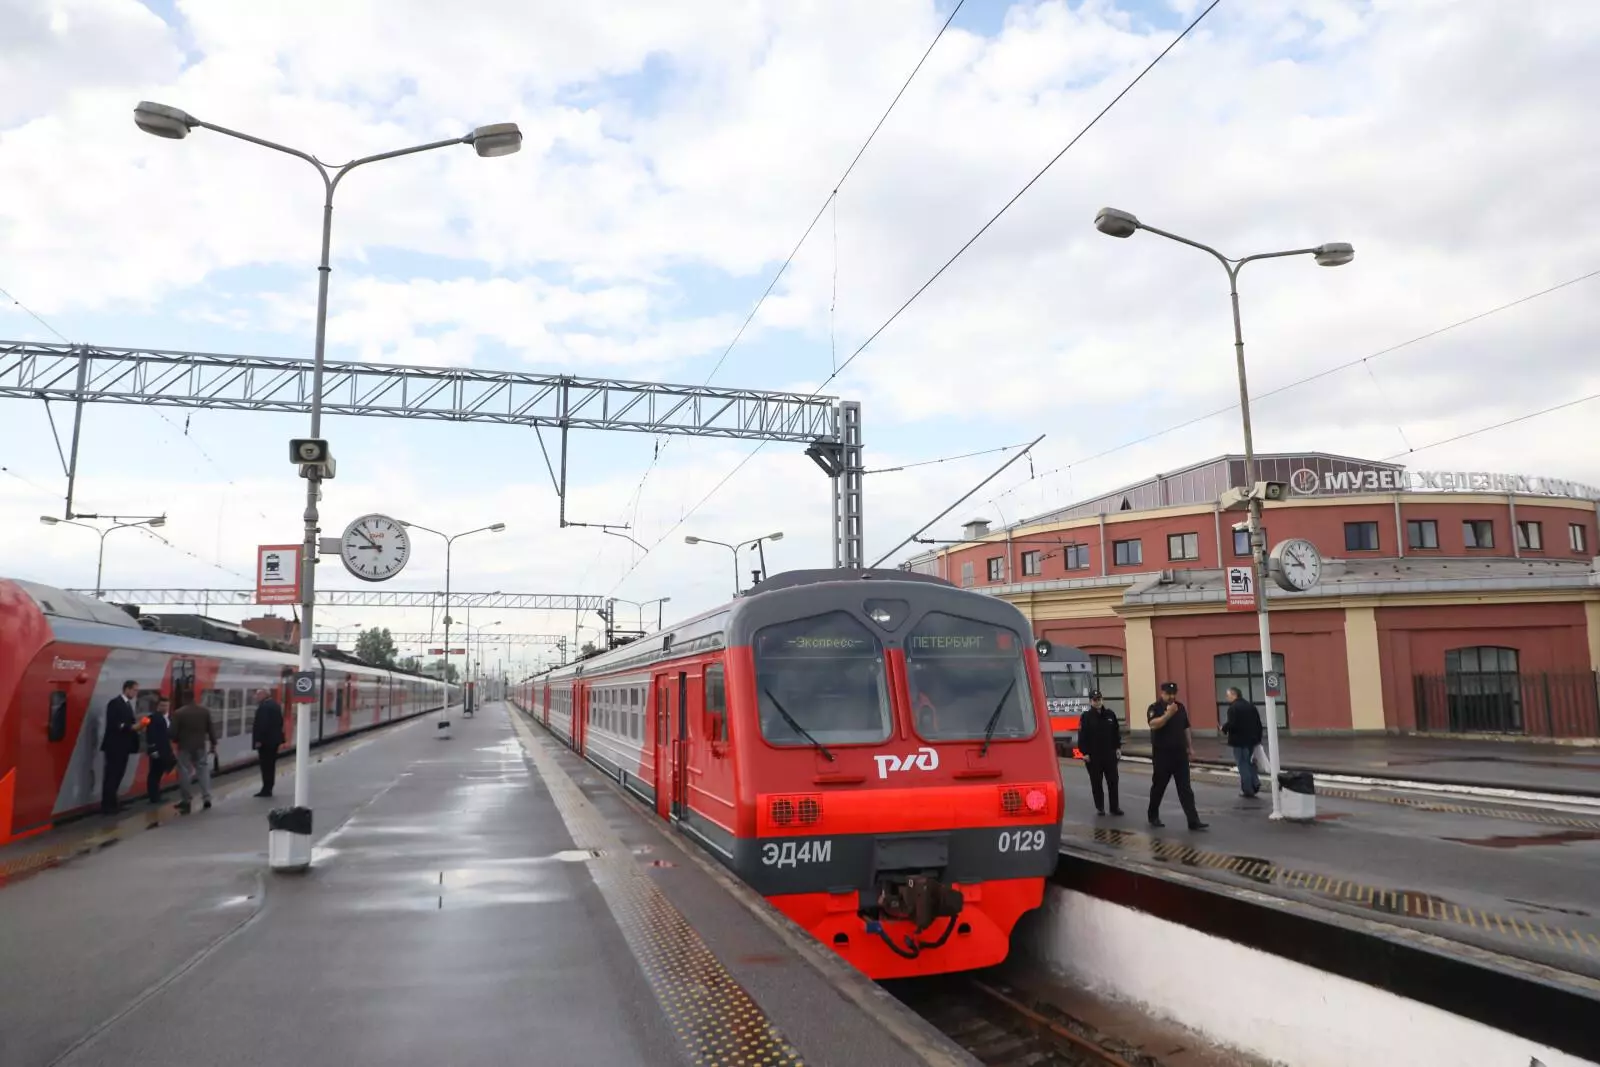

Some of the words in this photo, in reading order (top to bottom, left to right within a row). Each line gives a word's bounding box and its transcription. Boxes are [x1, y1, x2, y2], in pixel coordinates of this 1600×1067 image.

[913, 636, 983, 648] ПЕТЕРБУРГ
[998, 830, 1046, 853] 0129
[762, 840, 832, 868] ЭД4М
